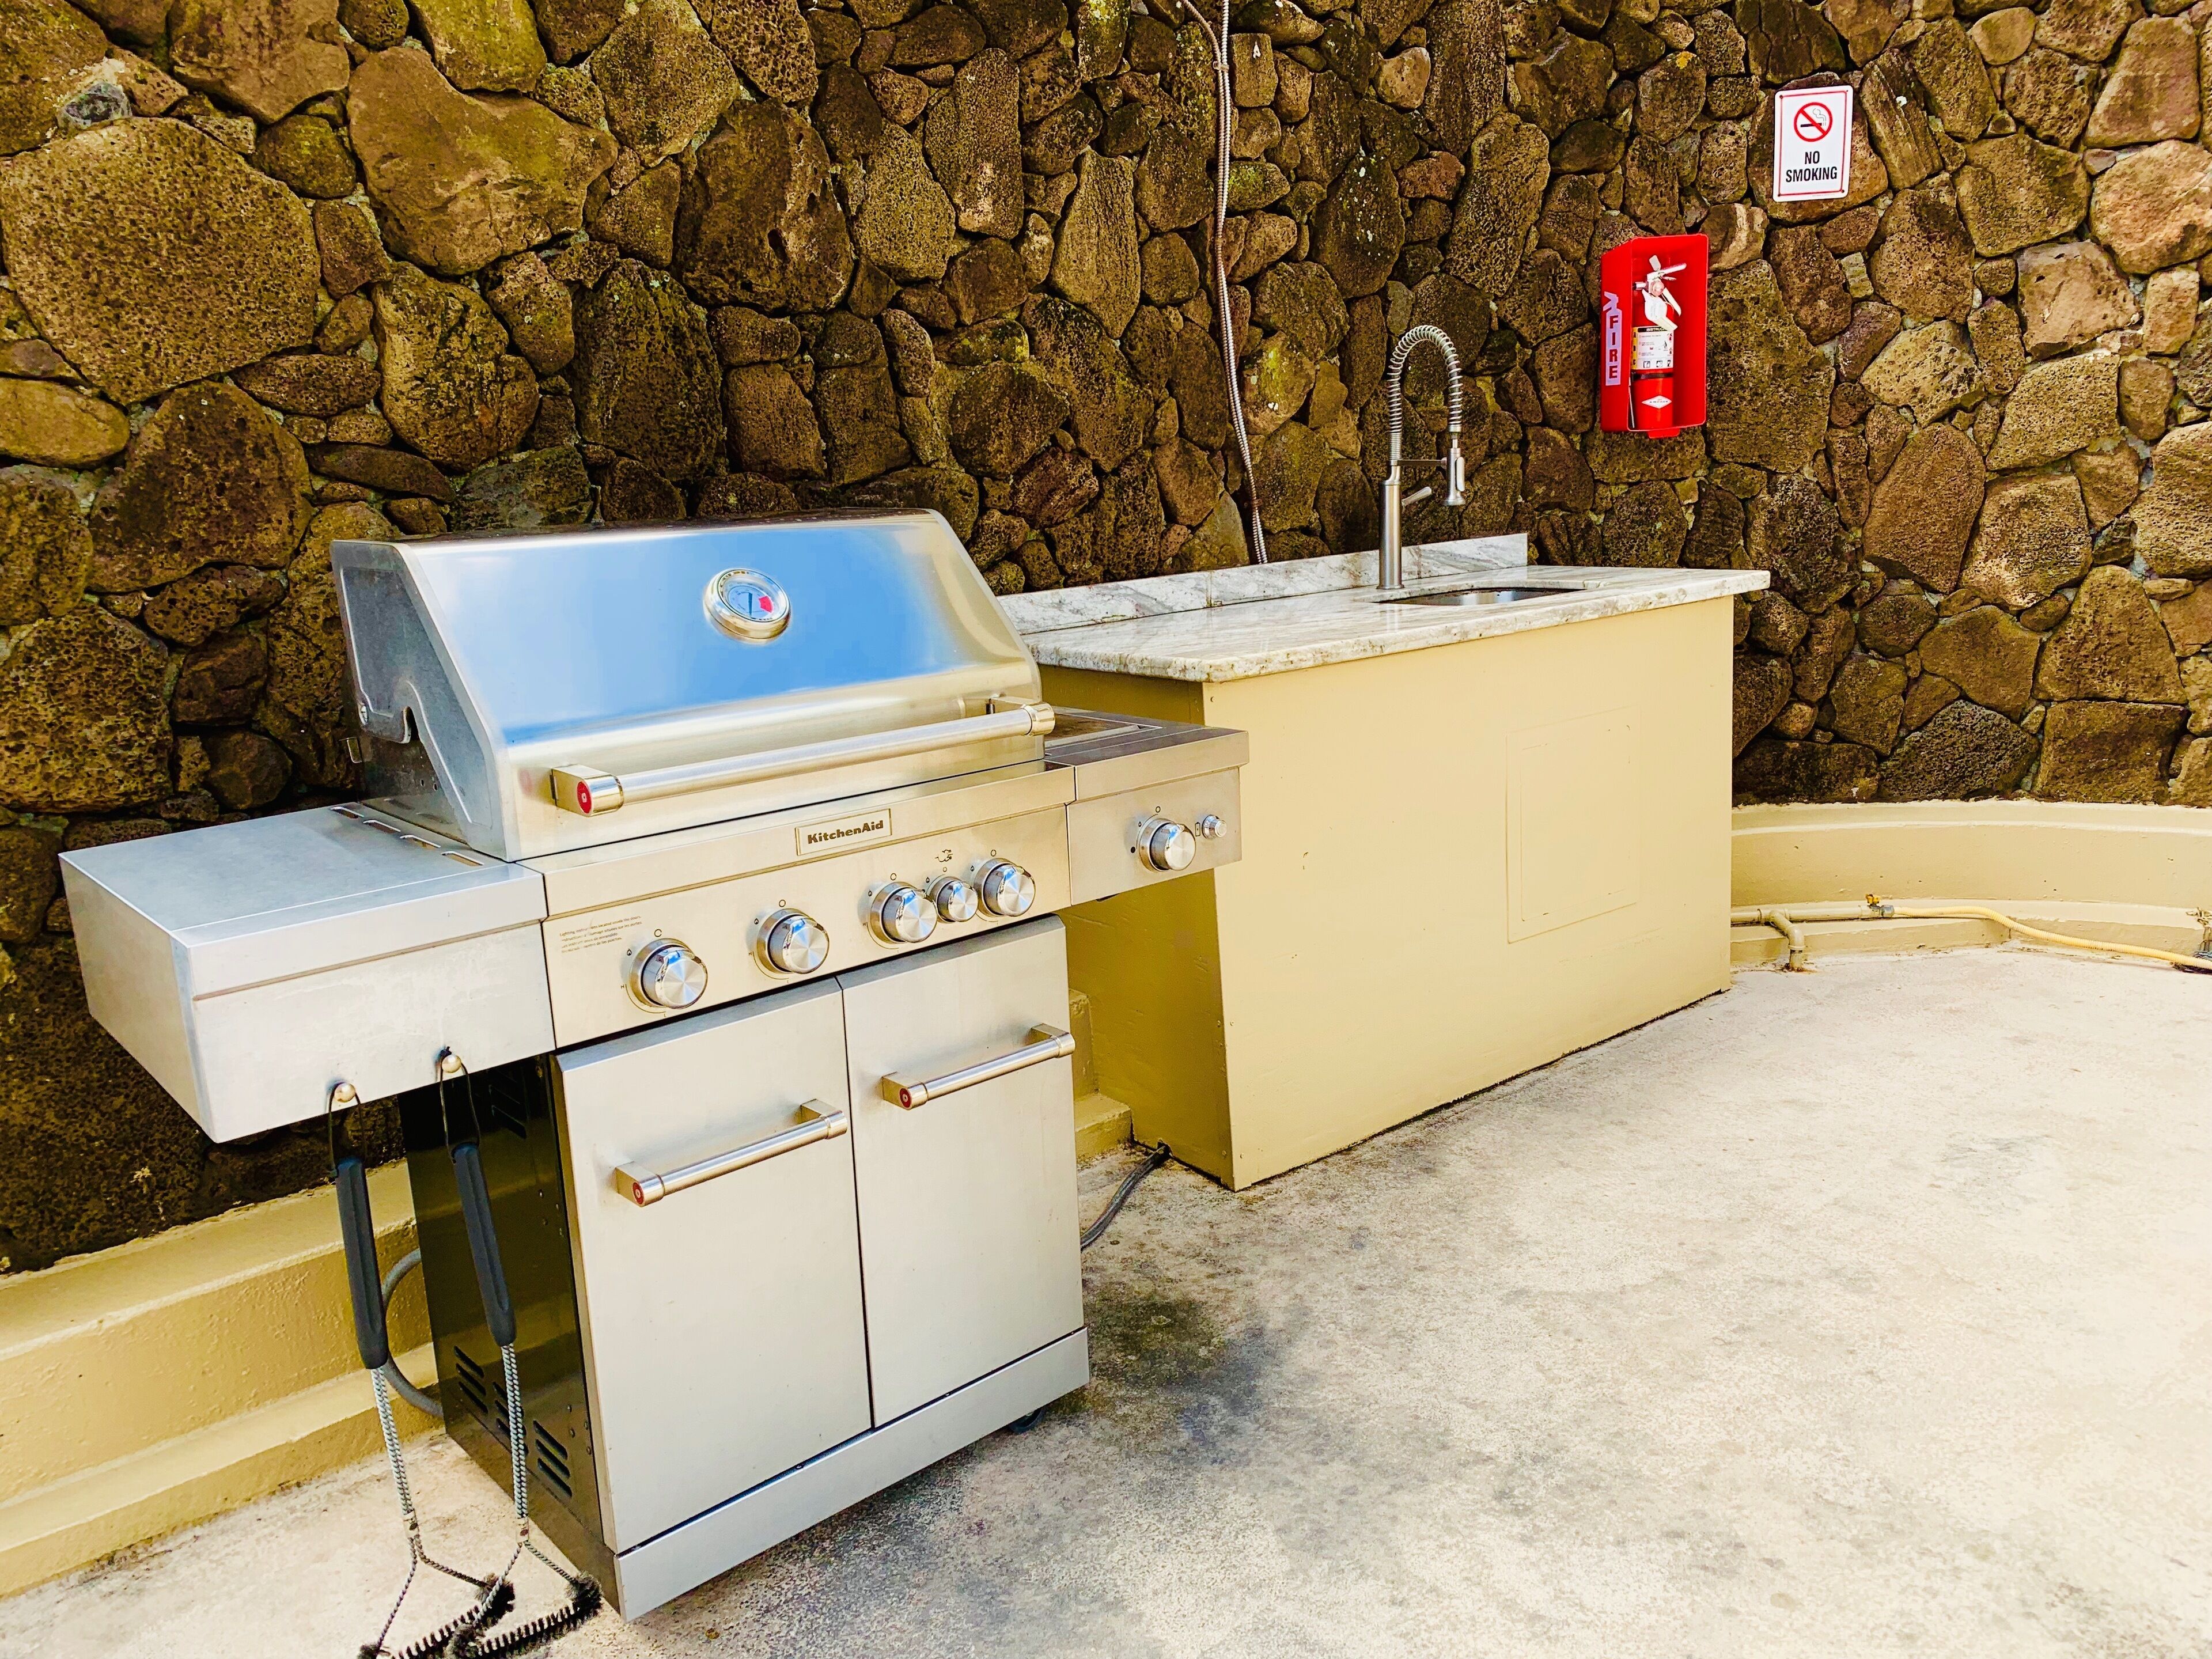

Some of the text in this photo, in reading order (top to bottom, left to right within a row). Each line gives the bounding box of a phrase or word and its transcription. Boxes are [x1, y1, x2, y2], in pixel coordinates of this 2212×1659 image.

[1804, 151, 1820, 164] NO
[1786, 166, 1838, 183] SMOKING
[1609, 315, 1619, 378] FIRE
[808, 820, 884, 844] KitchenAid
